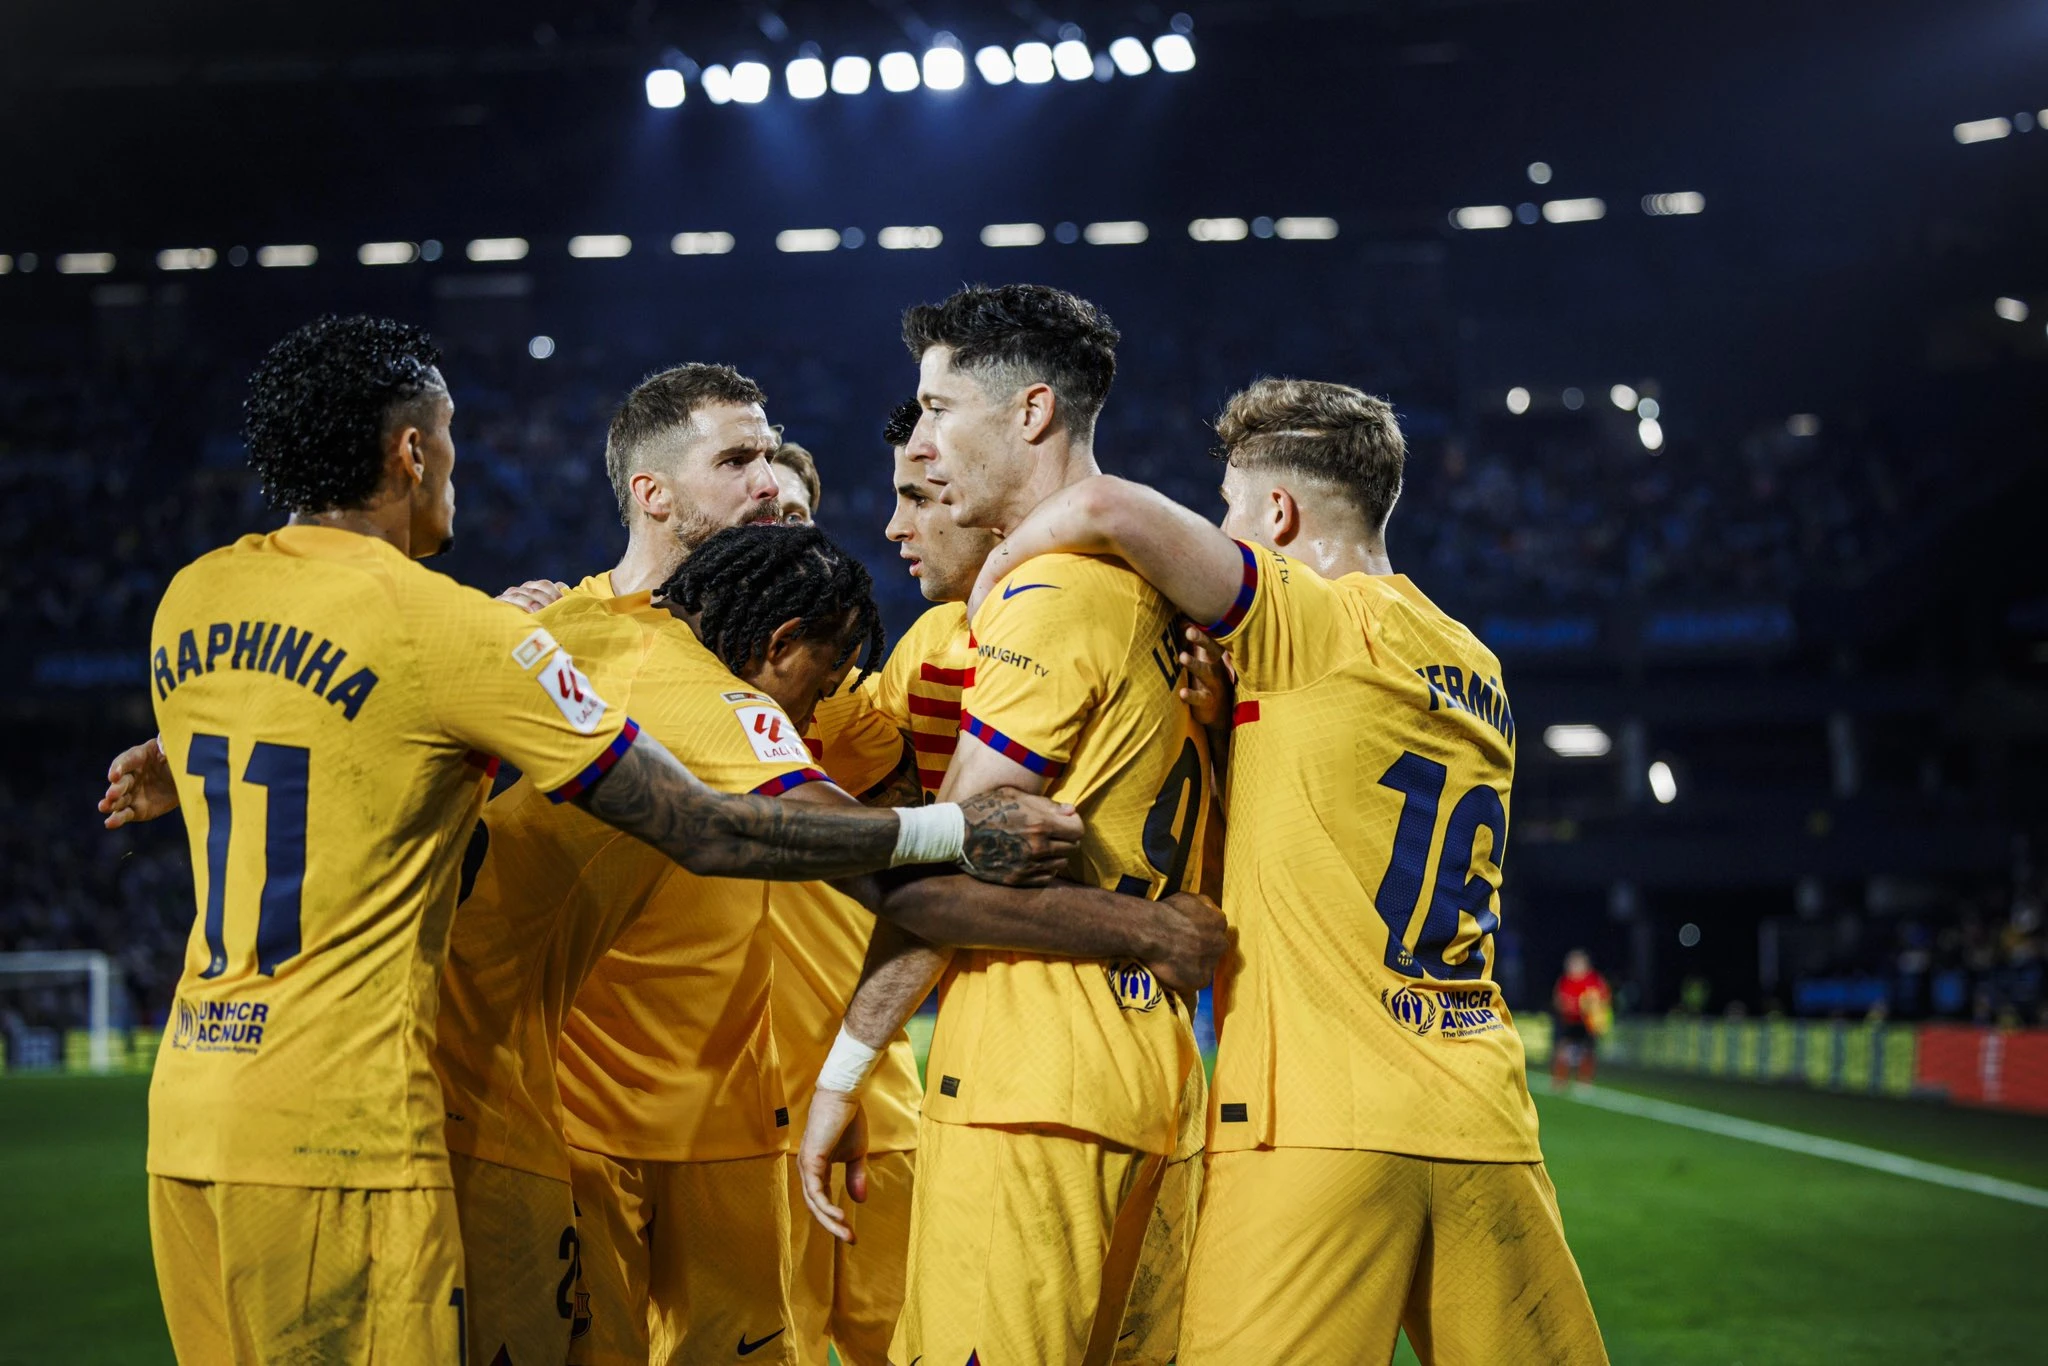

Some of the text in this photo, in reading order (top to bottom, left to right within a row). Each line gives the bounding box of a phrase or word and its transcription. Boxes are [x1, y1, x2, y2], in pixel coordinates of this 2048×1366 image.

[153, 621, 379, 722] RAPHINHA
[1034, 664, 1049, 677] tv
[187, 733, 310, 979] 11
[1375, 751, 1506, 981] 16
[197, 1023, 263, 1044] ACNUR
[199, 1000, 269, 1023] UNHCR
